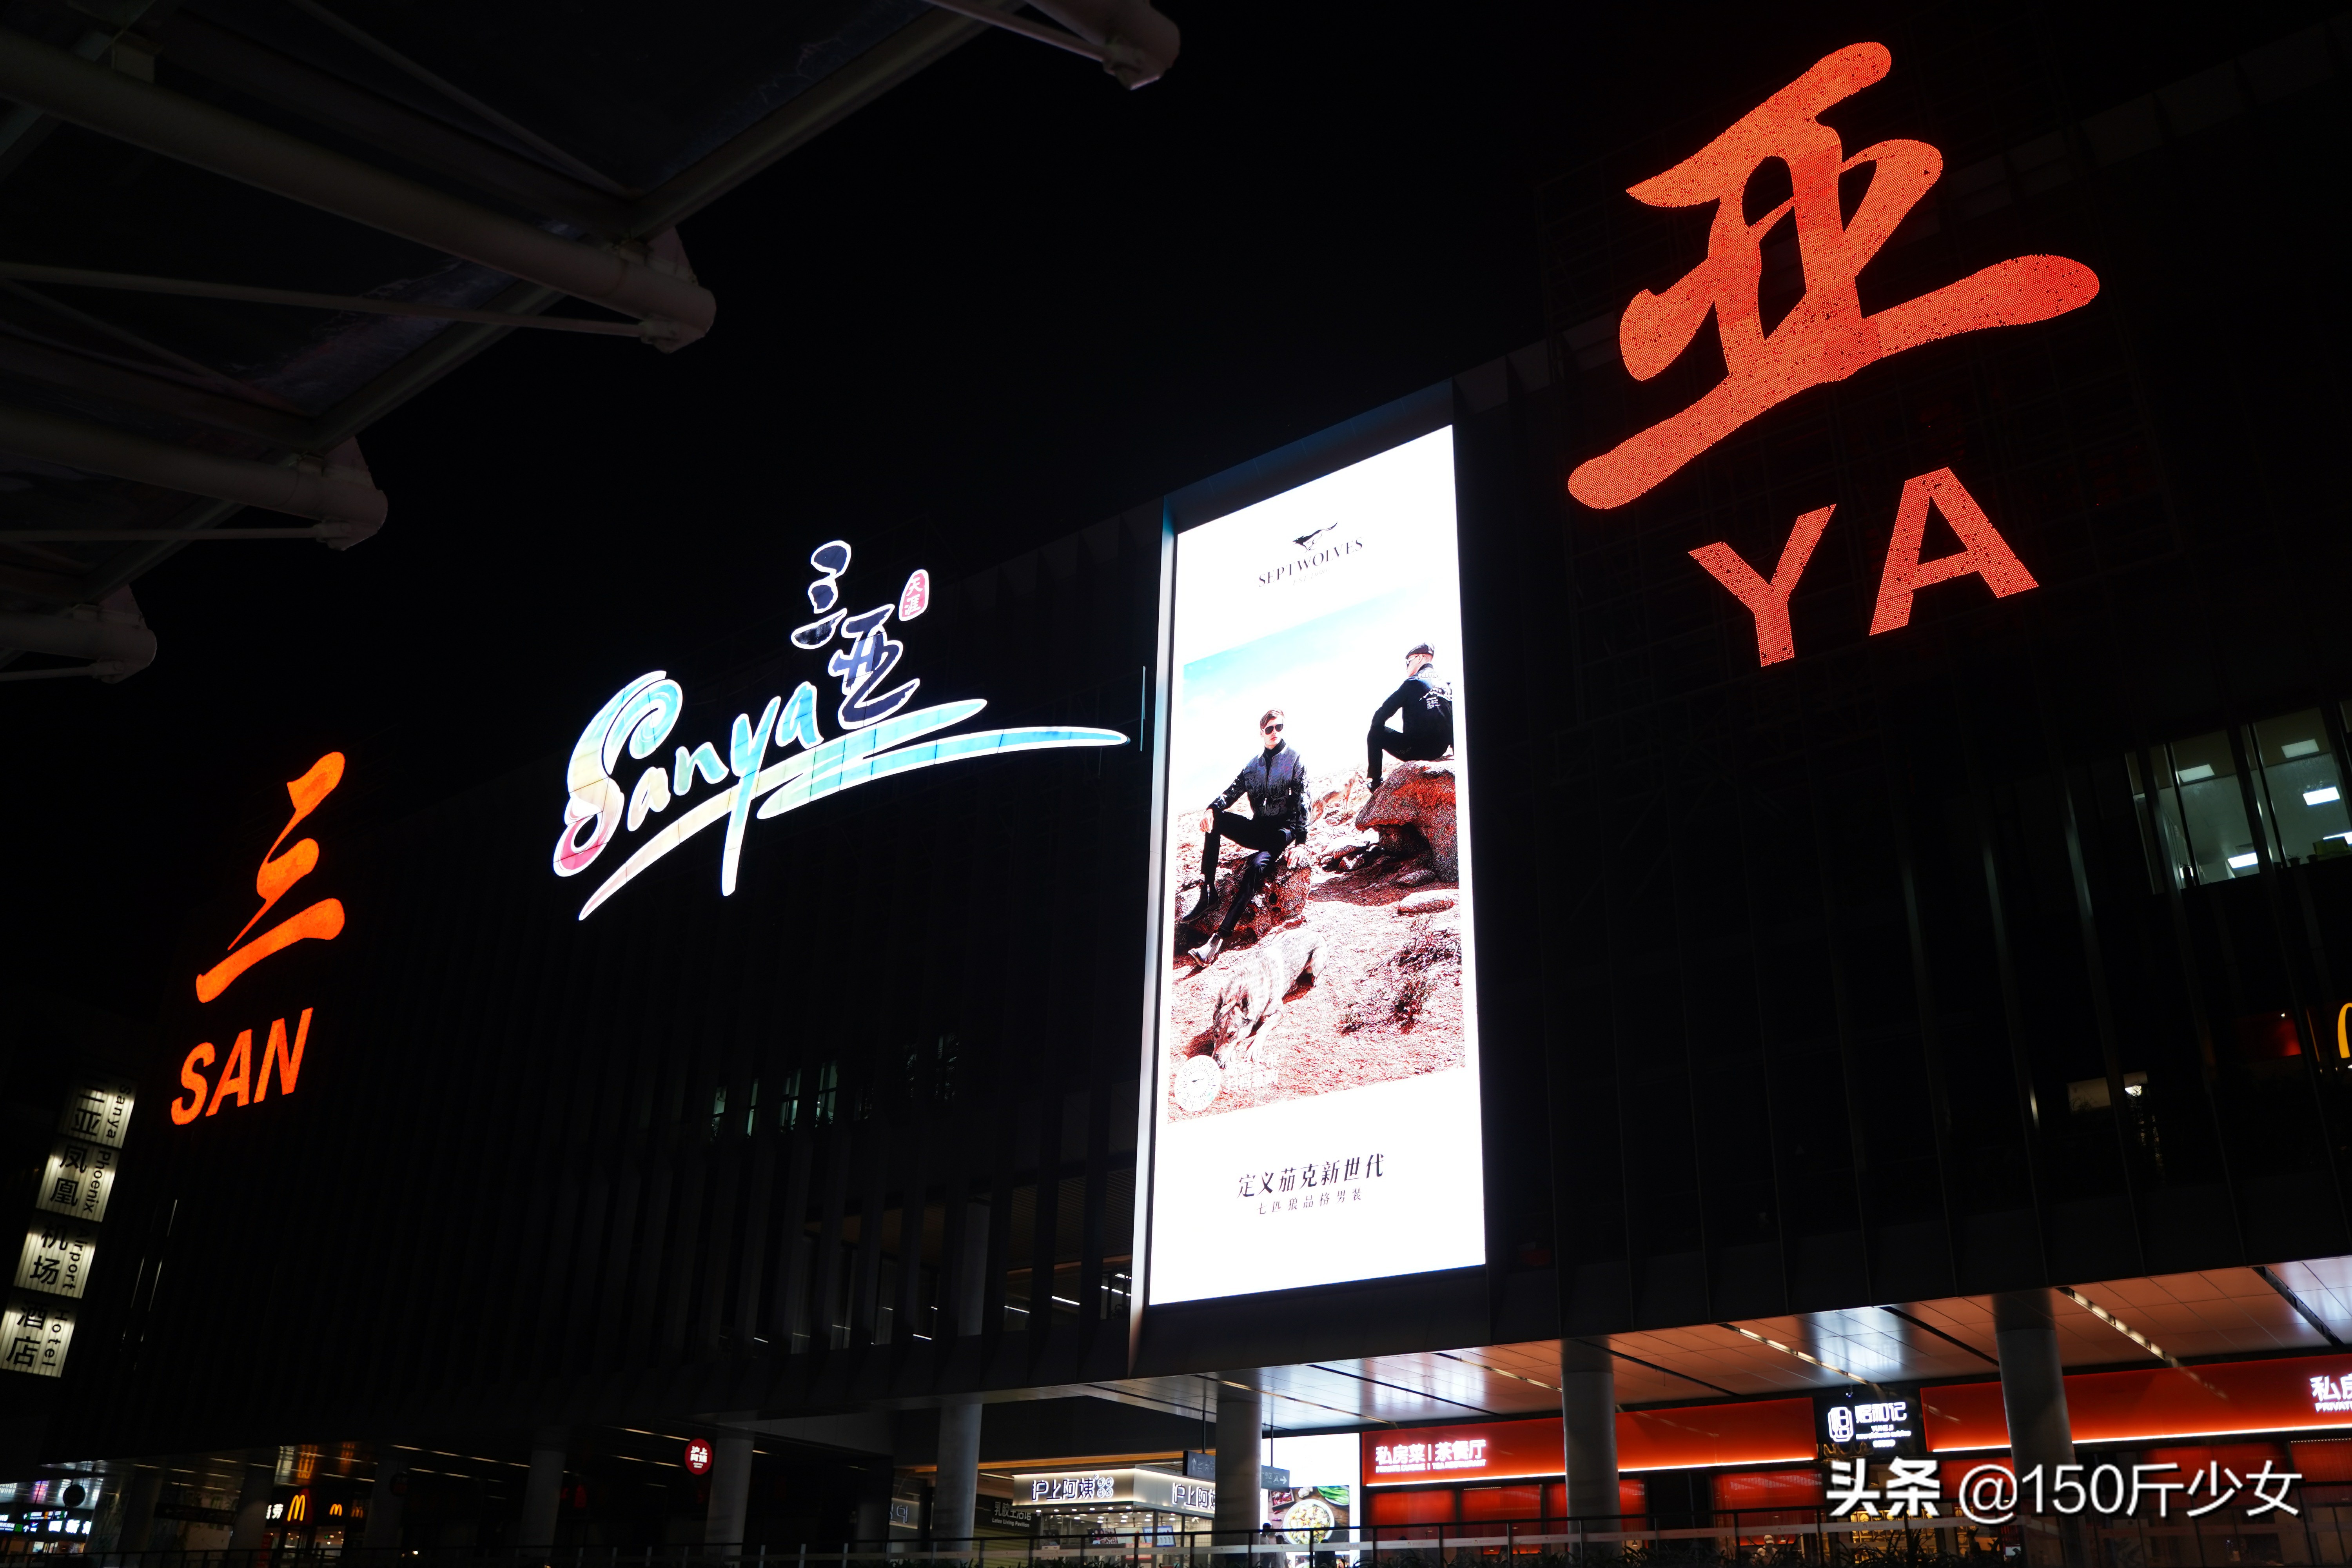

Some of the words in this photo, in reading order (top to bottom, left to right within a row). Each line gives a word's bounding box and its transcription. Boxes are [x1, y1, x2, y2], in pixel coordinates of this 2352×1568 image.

[1567, 42, 2100, 510] 亚
[1258, 536, 1363, 587] SEPTWOLVES
[1690, 466, 2040, 667] YA
[904, 577, 923, 615] 天涯
[554, 671, 824, 896] Sanya
[195, 751, 346, 1004] 三
[171, 1006, 314, 1126] SAN
[106, 1084, 132, 1139] Sanya
[83, 1150, 111, 1213] Phoenix
[1237, 1152, 1385, 1199] 定义茄克新世代
[1257, 1187, 1362, 1215] 七匹狼品格男装
[63, 1227, 90, 1290] Airport
[42, 1308, 69, 1367] Hotel
[2315, 1401, 2352, 1413] PRIVAT
[1376, 1444, 1426, 1465] 私房菜
[1435, 1439, 1486, 1461] 茶餐厅
